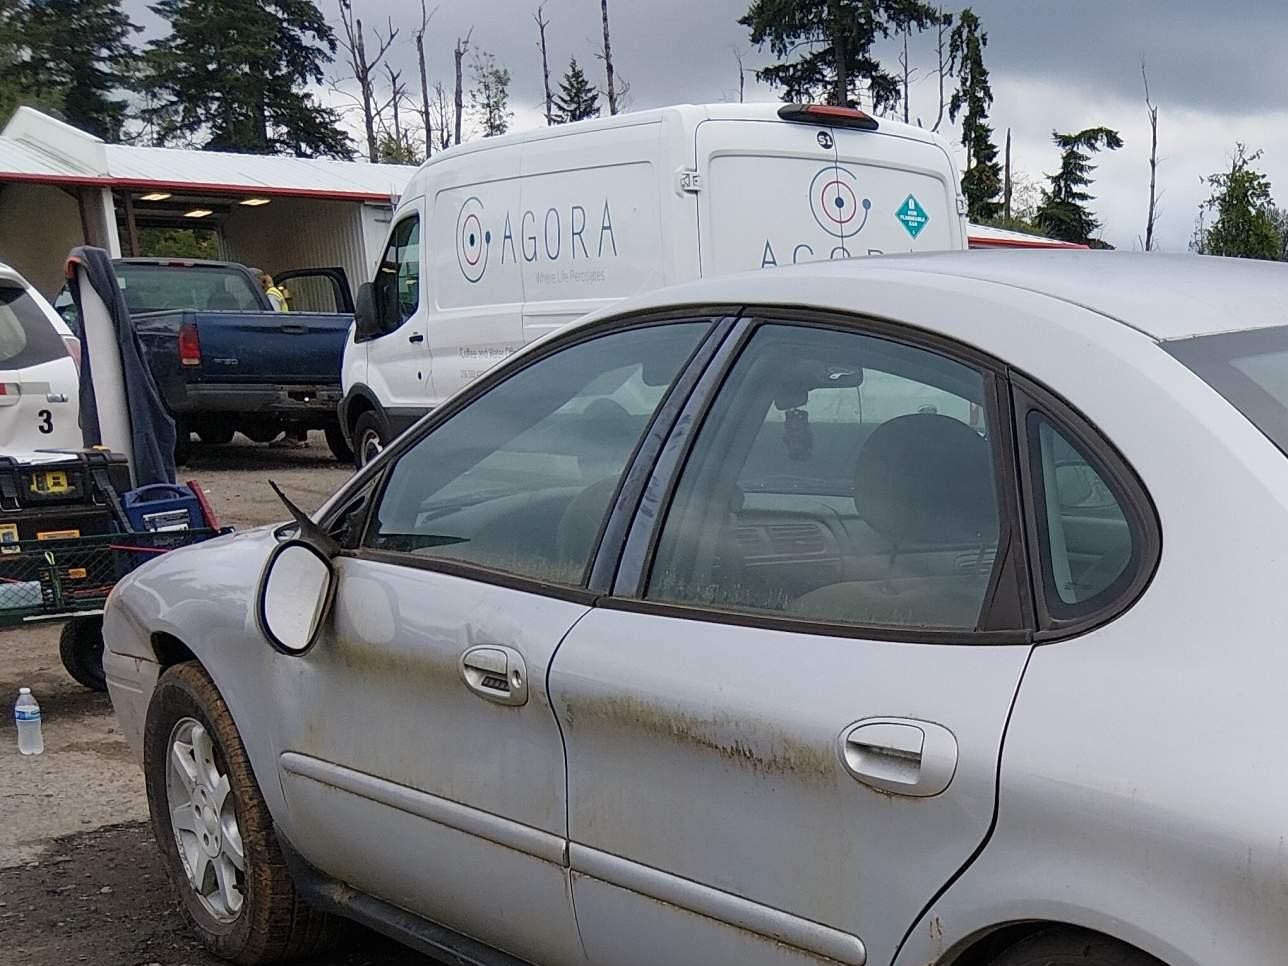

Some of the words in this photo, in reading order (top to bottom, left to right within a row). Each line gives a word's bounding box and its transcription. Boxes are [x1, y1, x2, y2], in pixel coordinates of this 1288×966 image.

[818, 135, 833, 145] S1
[501, 196, 618, 265] AGORA
[38, 409, 53, 434] 3
